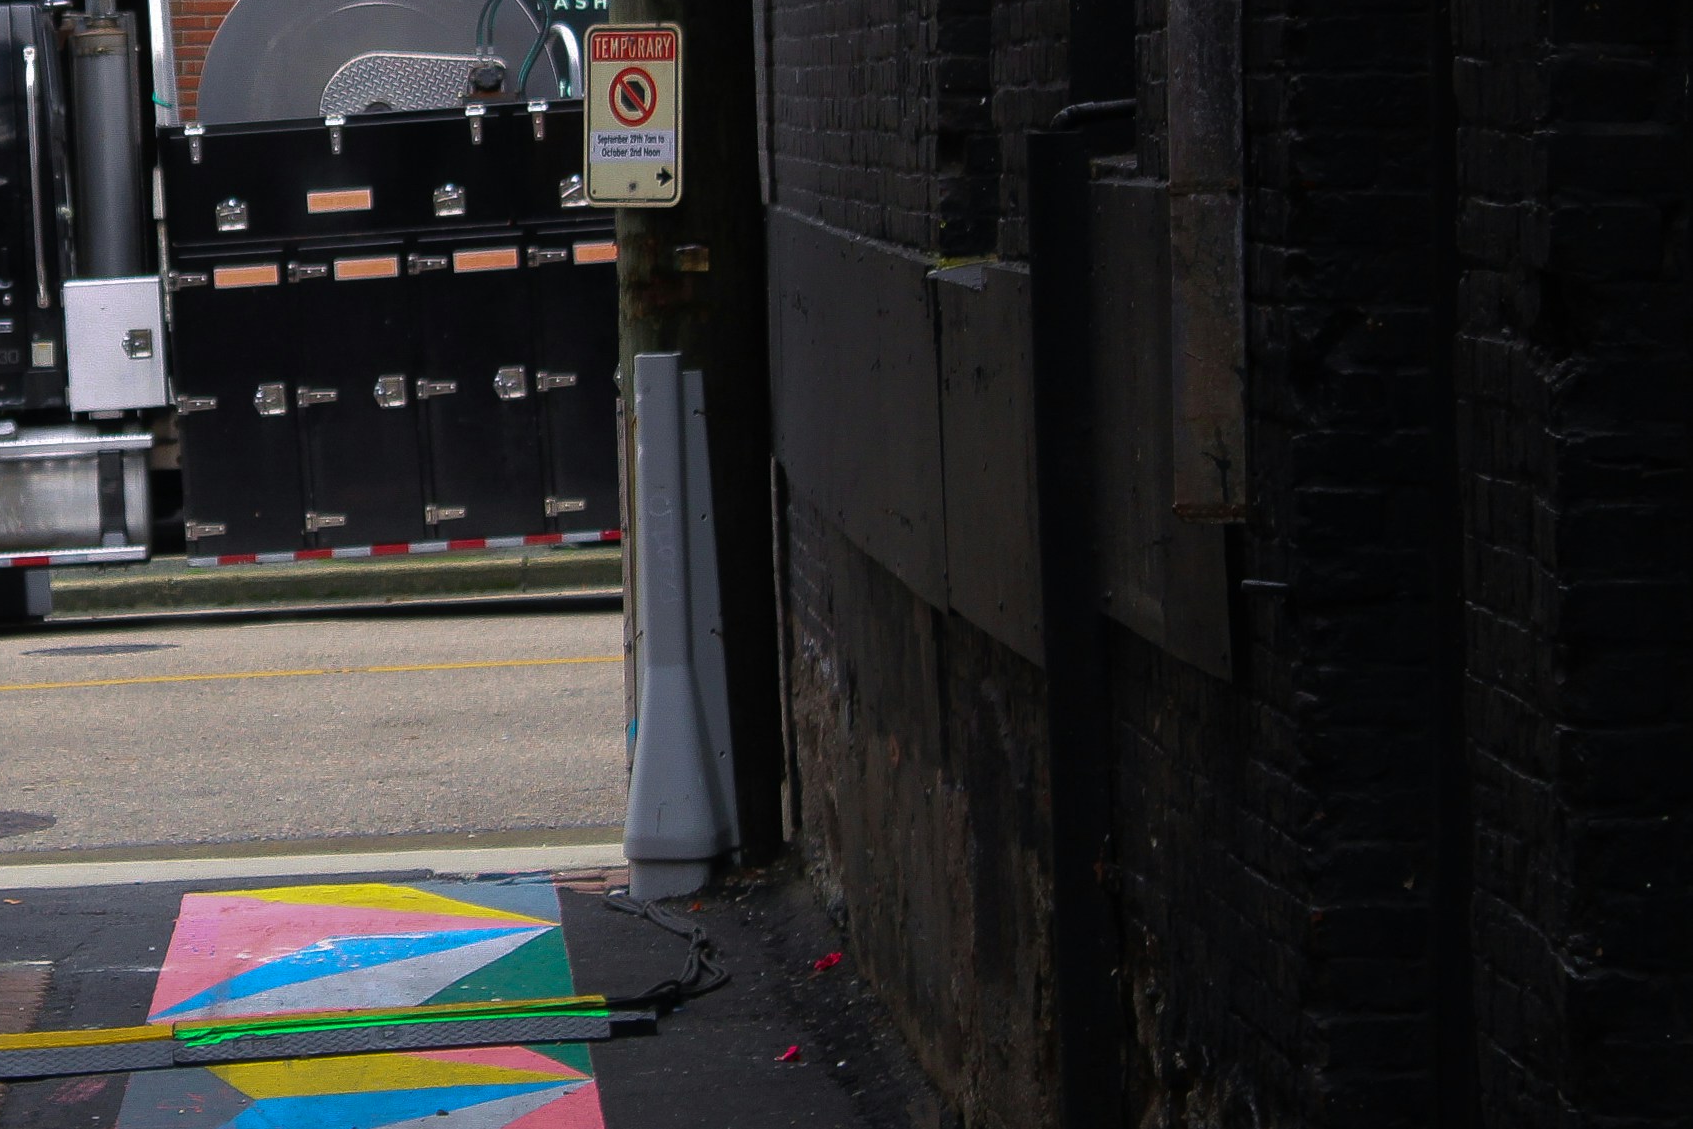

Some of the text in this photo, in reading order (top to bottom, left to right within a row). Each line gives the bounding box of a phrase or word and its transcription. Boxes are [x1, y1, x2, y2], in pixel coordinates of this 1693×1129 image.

[594, 35, 673, 59] TEMPORARY
[597, 134, 629, 146] September
[658, 134, 665, 144] to
[601, 147, 661, 157] October 2nd Noon
